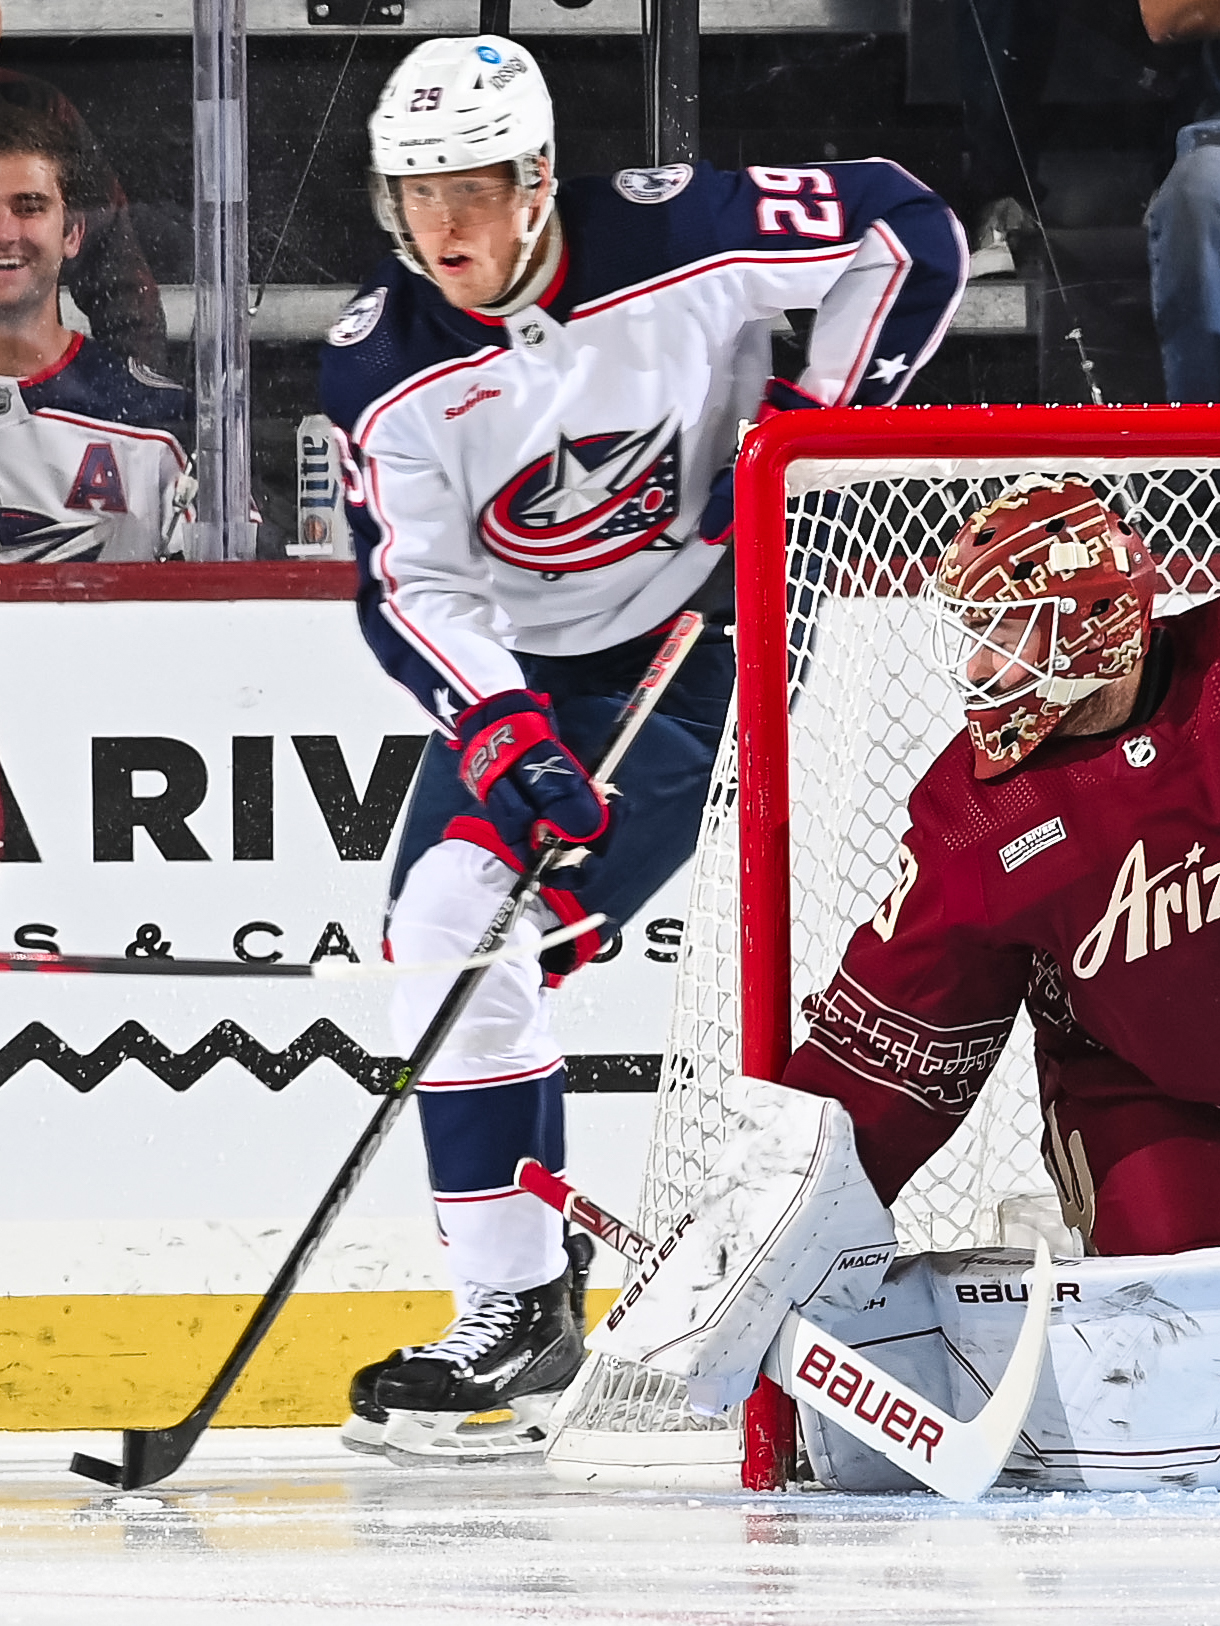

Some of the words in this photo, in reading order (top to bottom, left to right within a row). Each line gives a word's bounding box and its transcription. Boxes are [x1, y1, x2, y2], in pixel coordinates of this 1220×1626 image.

[409, 86, 444, 113] 29
[747, 164, 846, 242] 29
[64, 442, 129, 513] A
[92, 734, 432, 863] RIV
[605, 1212, 696, 1333] BAUER
[837, 1251, 890, 1271] MACH
[955, 1283, 1082, 1304] BAUR
[796, 1343, 944, 1464] BAUER
